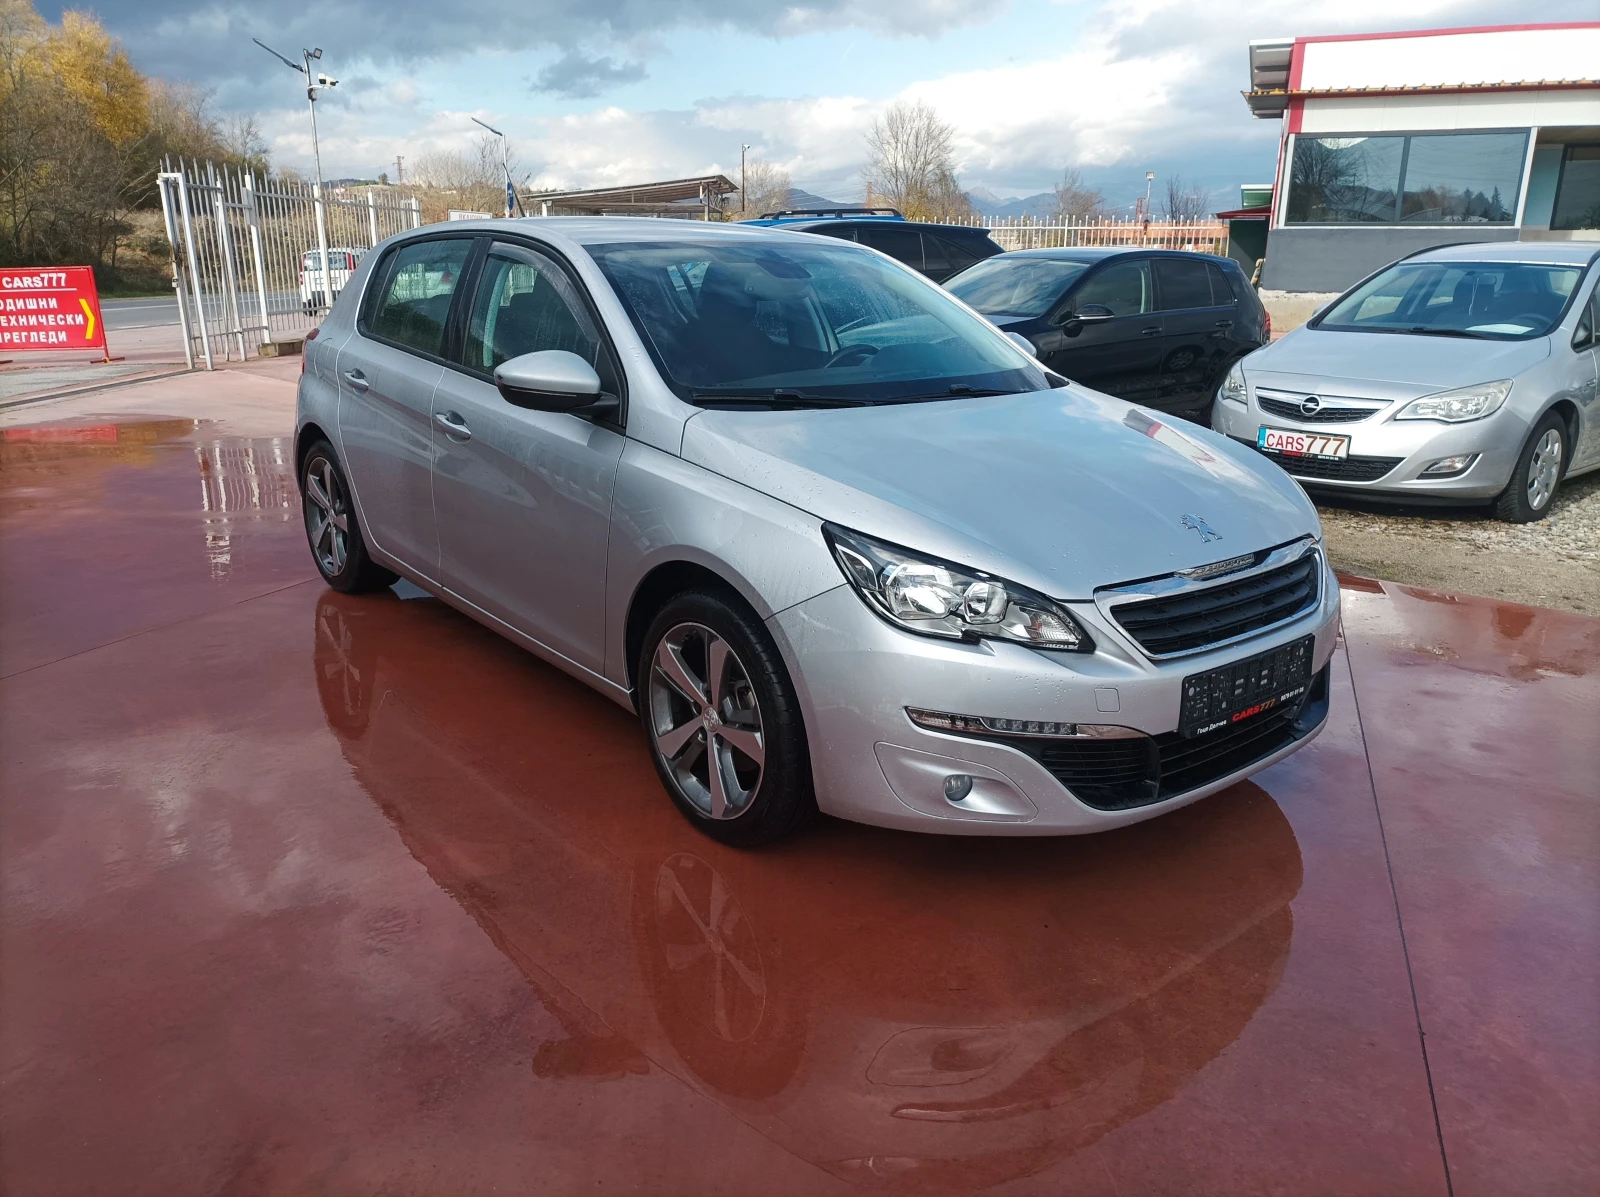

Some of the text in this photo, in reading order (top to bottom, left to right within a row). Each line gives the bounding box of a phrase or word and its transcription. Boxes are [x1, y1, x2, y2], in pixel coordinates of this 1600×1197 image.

[2, 273, 66, 288] CARS777
[0, 331, 67, 343] РЕГЛЕДИ
[1266, 433, 1346, 456] CARS777
[1232, 698, 1276, 722] CARS777
